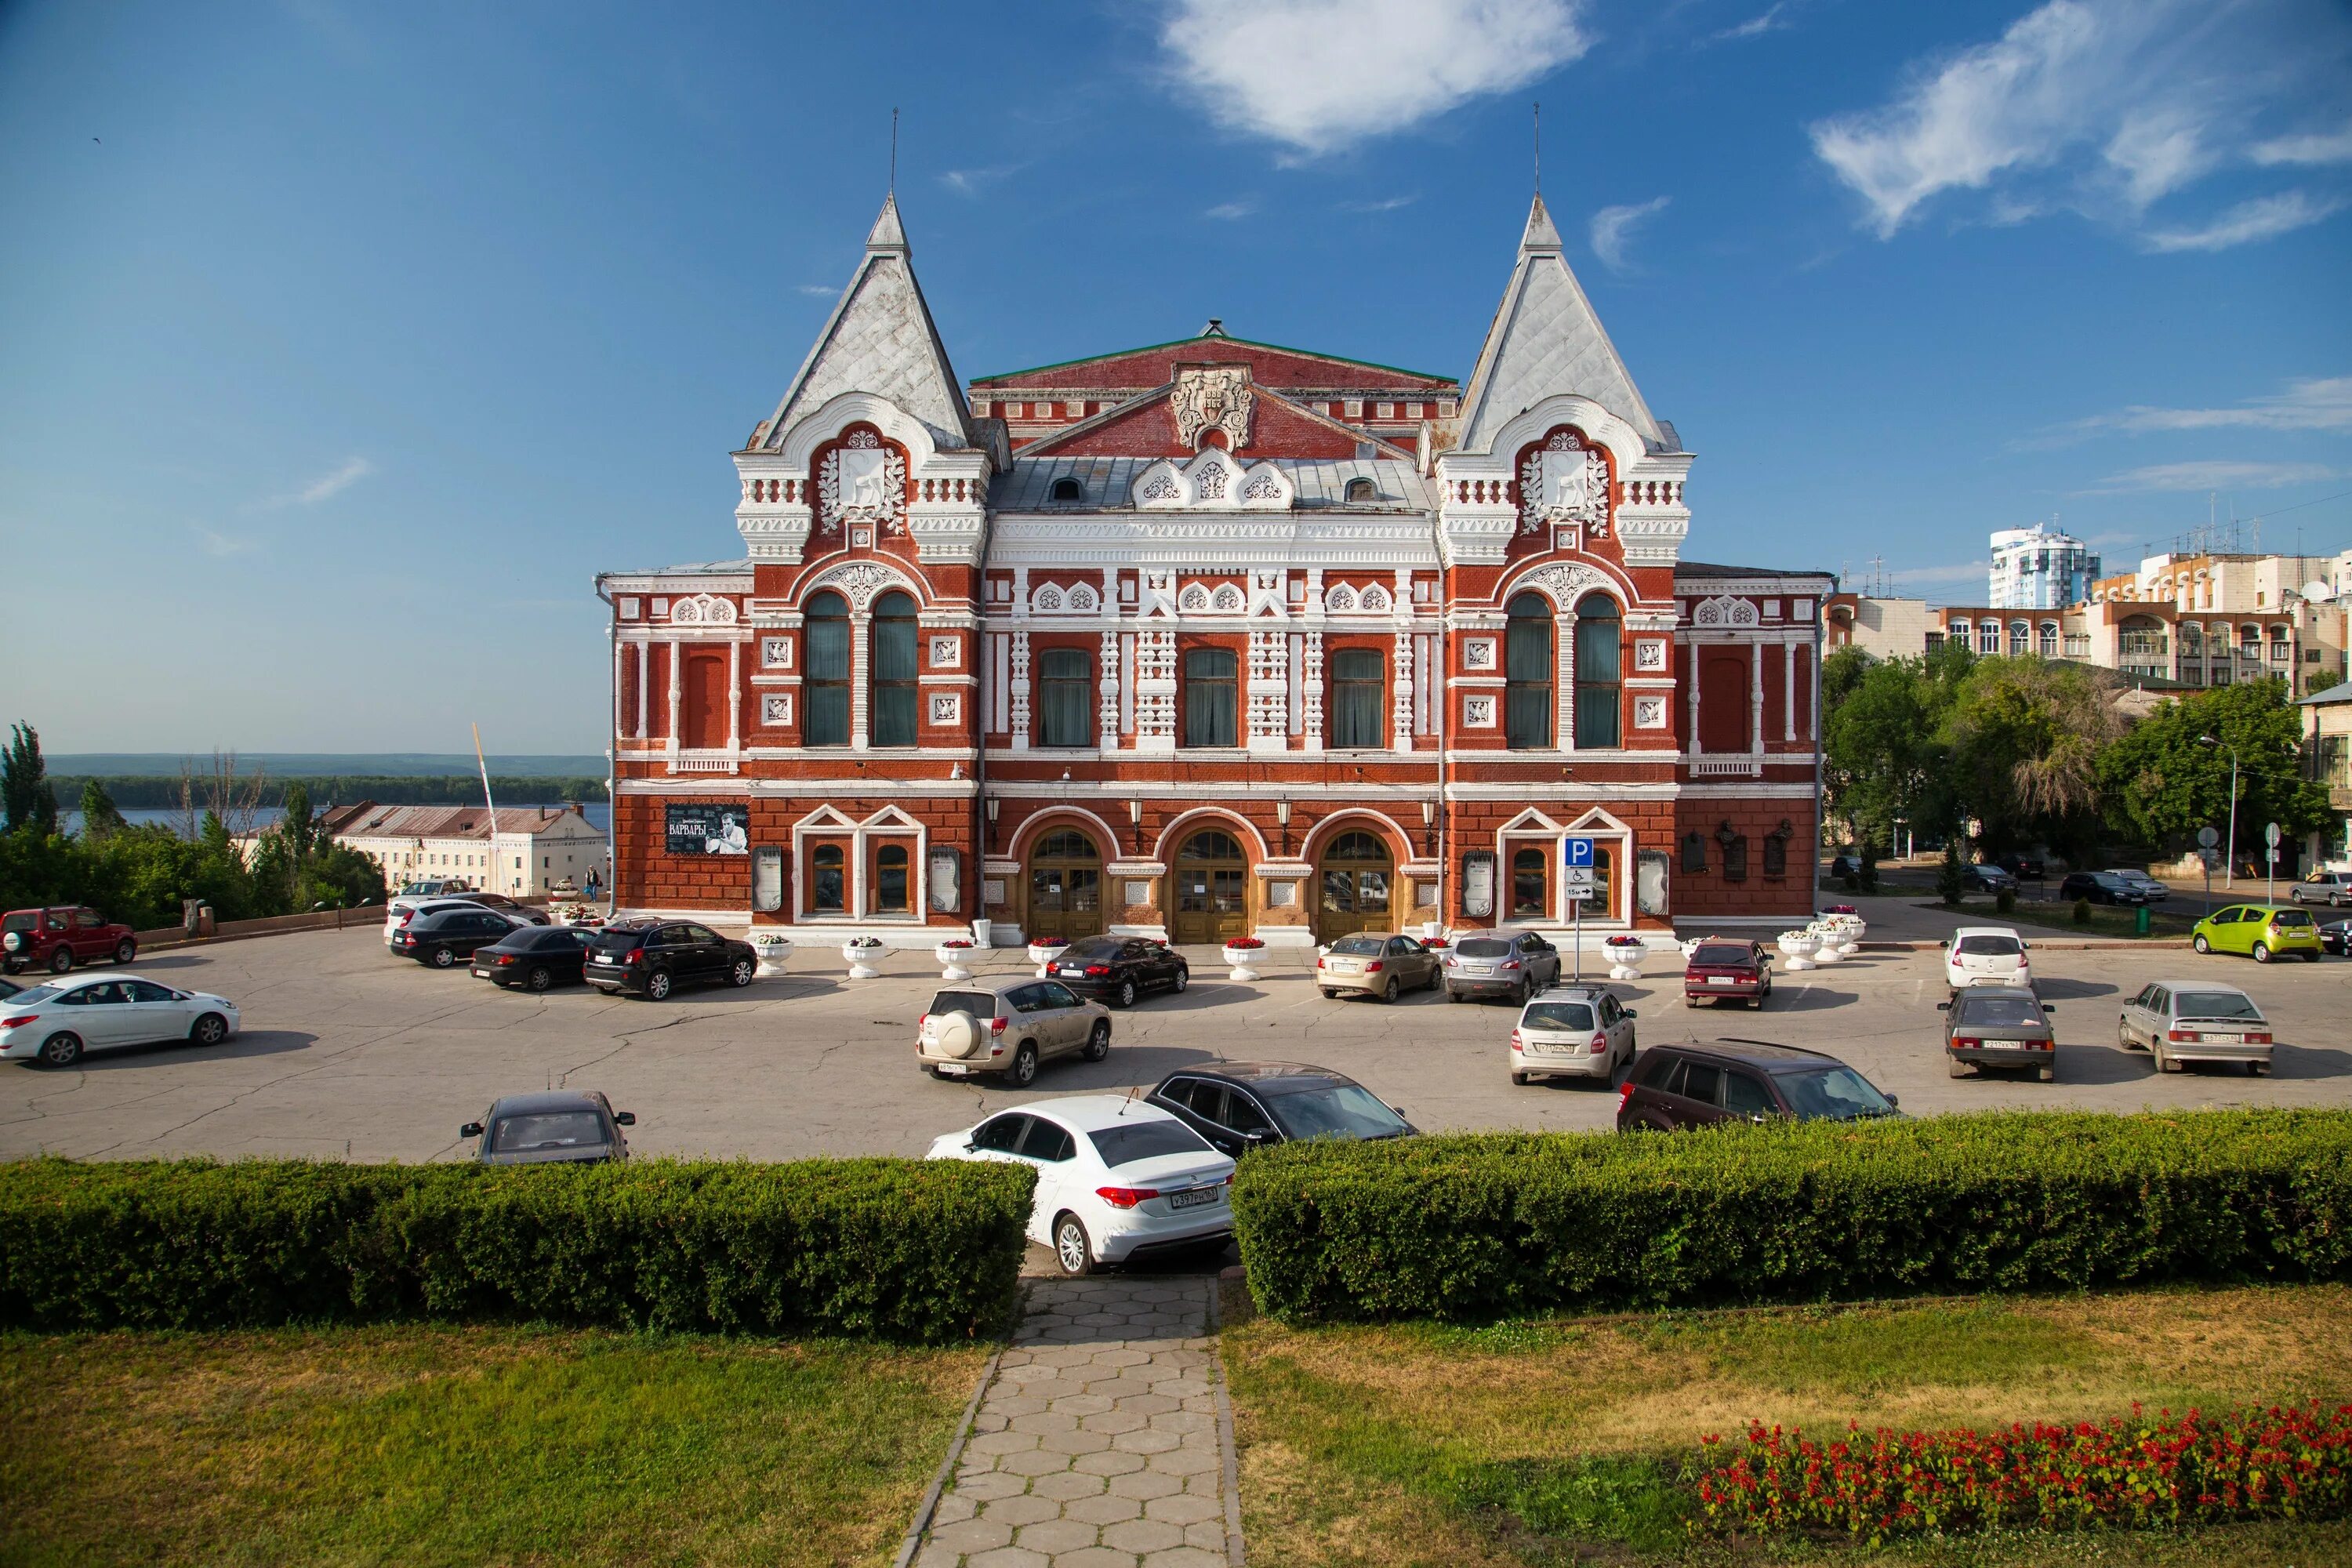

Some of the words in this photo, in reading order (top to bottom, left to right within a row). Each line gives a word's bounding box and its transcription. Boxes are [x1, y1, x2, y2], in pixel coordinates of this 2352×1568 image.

[1204, 389, 1221, 397] 1888
[669, 824, 706, 835] ВАРВАРЫ
[1573, 841, 1588, 863] P
